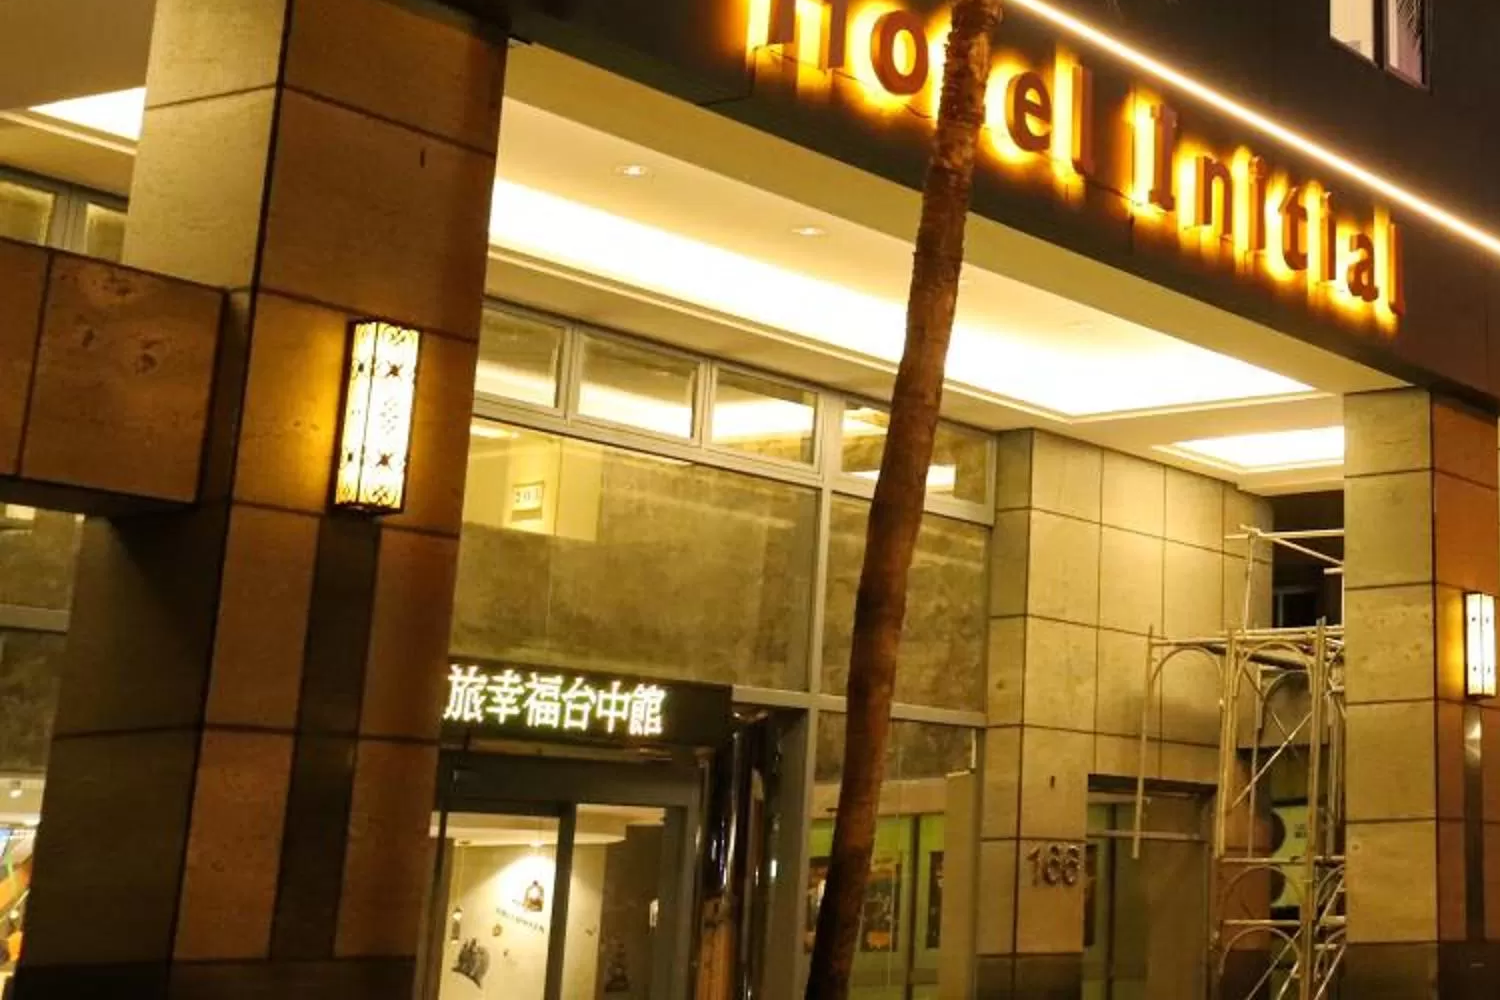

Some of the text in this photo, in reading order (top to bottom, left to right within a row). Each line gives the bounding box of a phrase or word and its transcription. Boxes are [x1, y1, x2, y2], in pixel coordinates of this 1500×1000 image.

[1130, 92, 1404, 322] Initial
[443, 663, 667, 737] 旅幸福台中館
